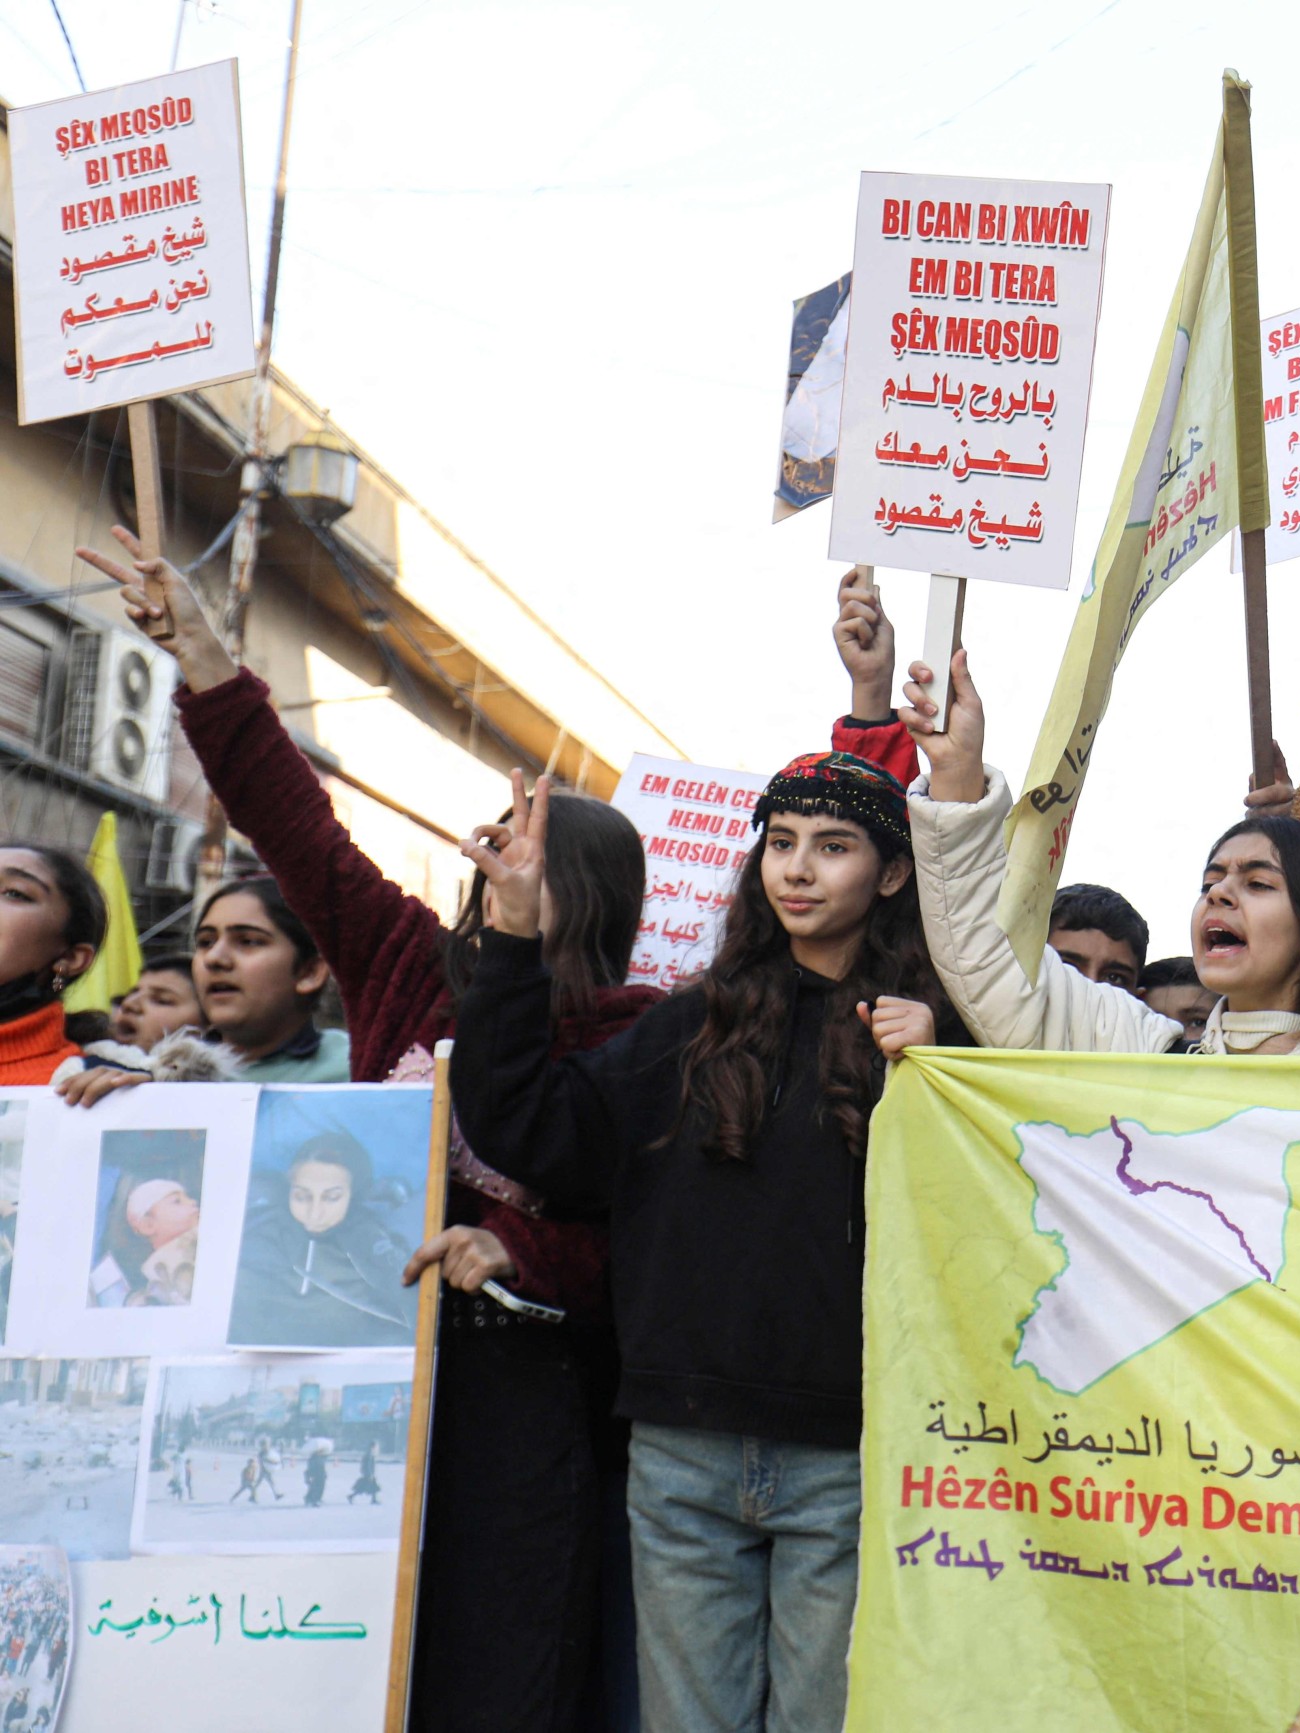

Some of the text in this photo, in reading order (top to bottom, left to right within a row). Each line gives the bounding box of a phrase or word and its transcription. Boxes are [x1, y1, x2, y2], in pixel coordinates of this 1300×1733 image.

[56, 97, 193, 156] ŞÊX MEQSÛD
[85, 144, 169, 185] BI TERA
[61, 175, 198, 232] HEYA MIRINE
[882, 199, 1089, 246] BI CAN BI XWÎN
[59, 216, 206, 282] شيخ مقصود
[60, 269, 210, 334] نحن معكم
[909, 258, 1056, 302] EM BI TERA
[63, 320, 212, 379] للموت
[891, 307, 1059, 360] ŞÊX MEQSÛD
[883, 372, 1055, 427] بالروح بالدم
[1263, 396, 1282, 422] M
[875, 431, 1048, 478] نحن معك
[875, 493, 1042, 548] شيخ مقصود
[640, 774, 764, 809] EM GELÊN CE
[668, 810, 749, 838] HEMU BI
[648, 837, 729, 867] MEQSÛD
[925, 1401, 1163, 1467] الديمقراطية
[901, 1464, 1041, 1516] Hêzên
[1047, 1472, 1191, 1537] Sûriya
[241, 1594, 368, 1640] كلنا
